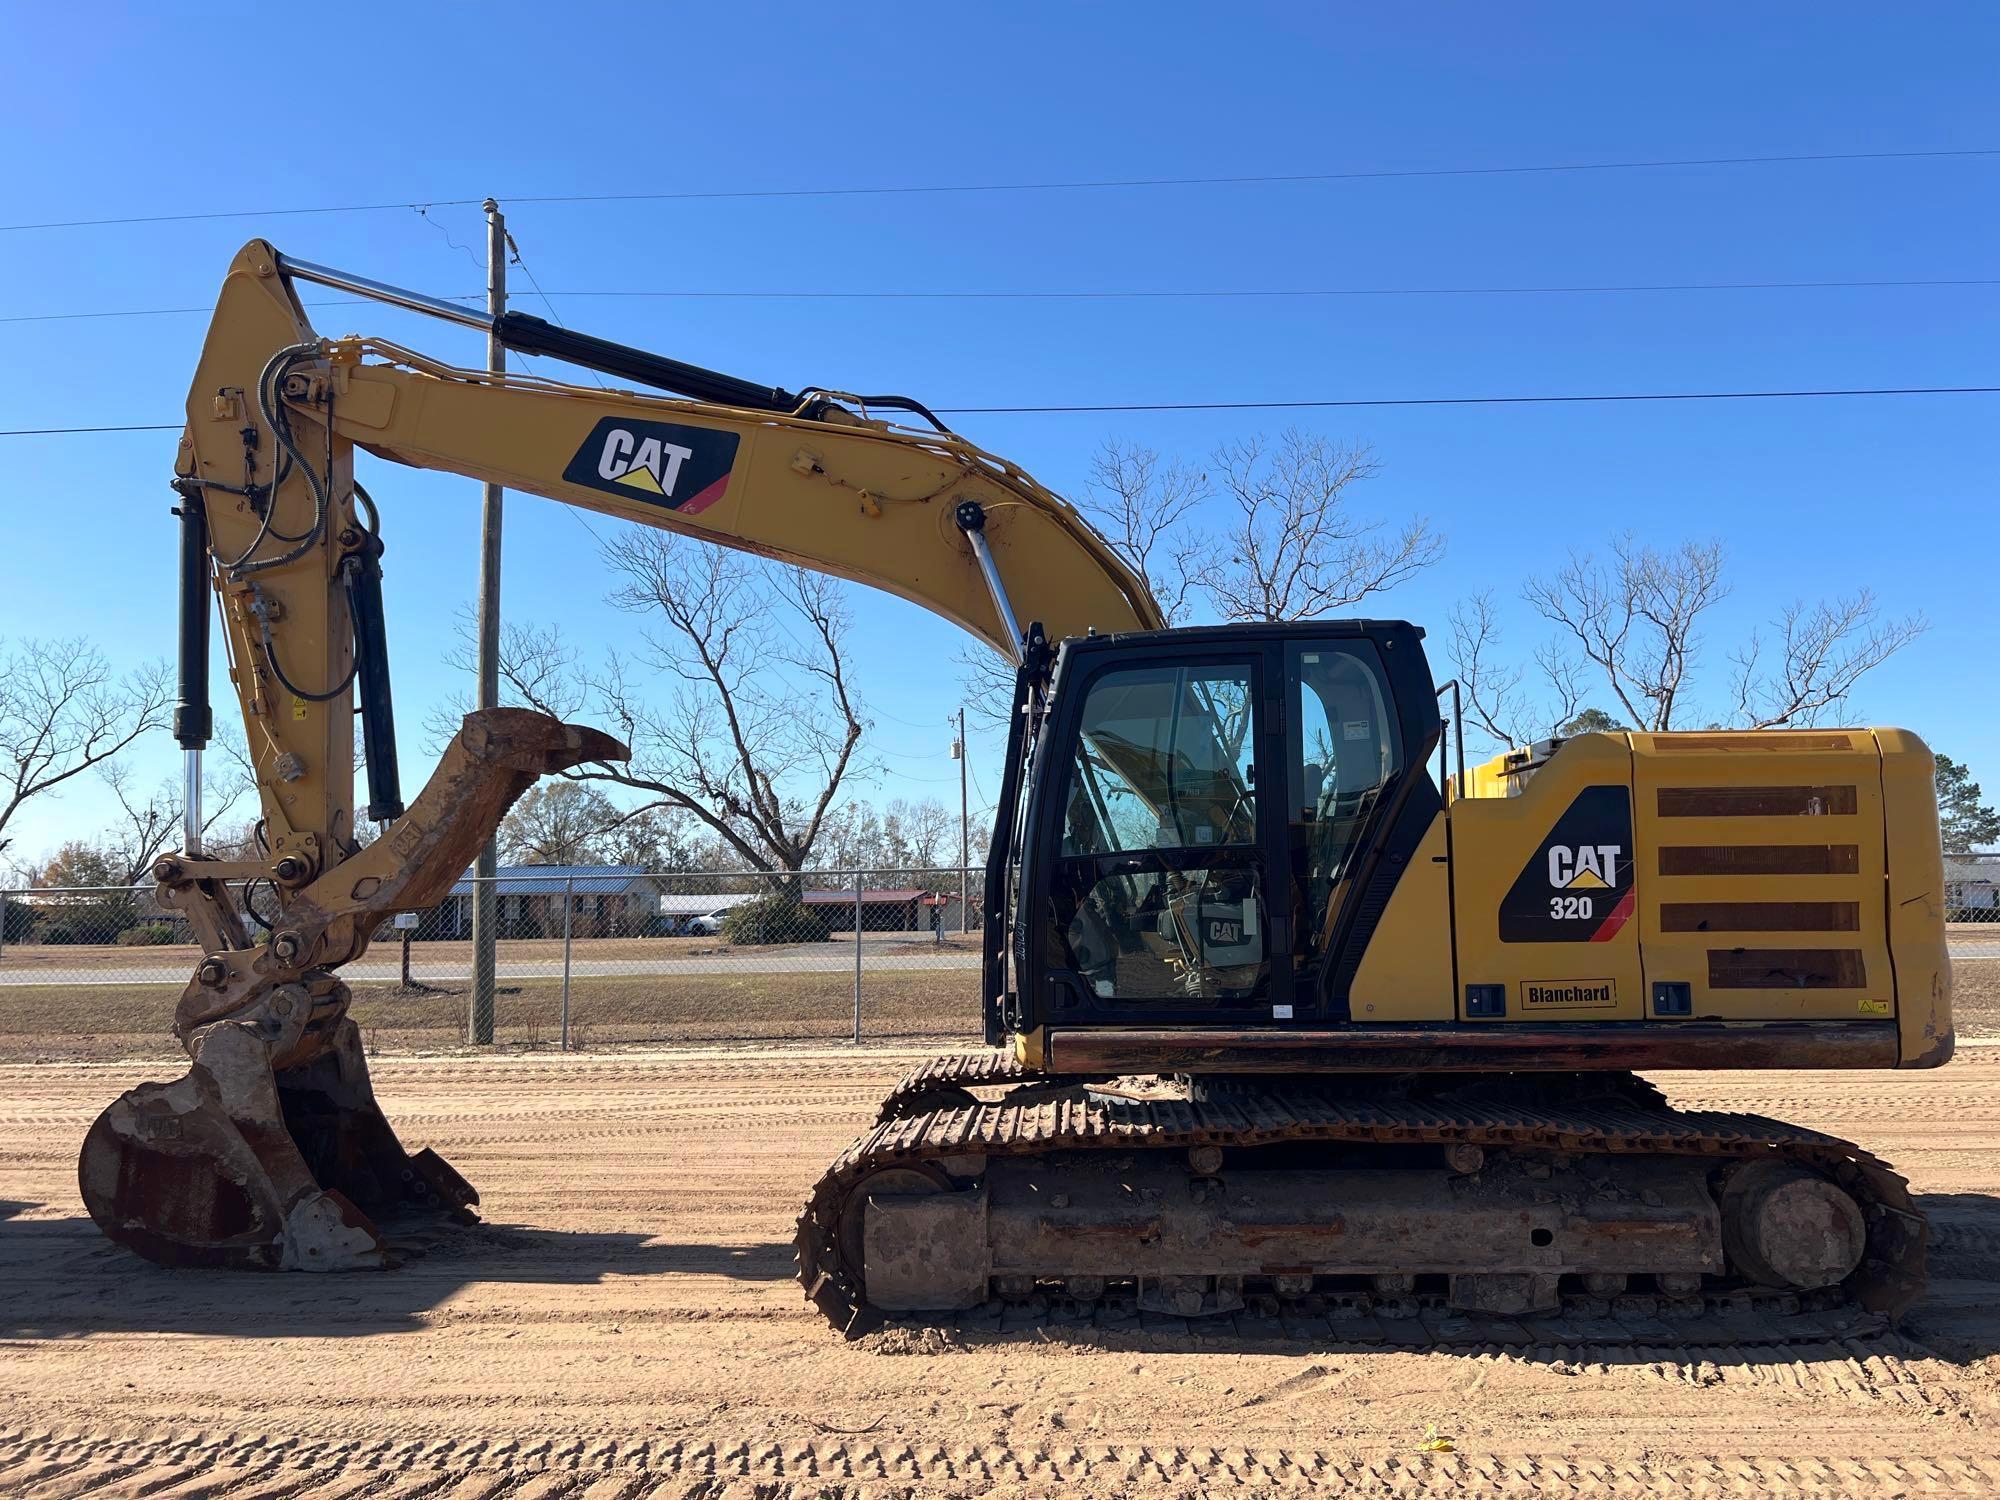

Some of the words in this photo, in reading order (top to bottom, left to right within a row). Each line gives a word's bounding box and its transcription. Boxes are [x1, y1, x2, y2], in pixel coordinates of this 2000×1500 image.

[598, 429, 692, 497] CAT
[1549, 845, 1620, 888] CAT
[1550, 897, 1593, 919] 320
[1210, 921, 1241, 942] CAT
[1529, 985, 1610, 1003] Blanchard
